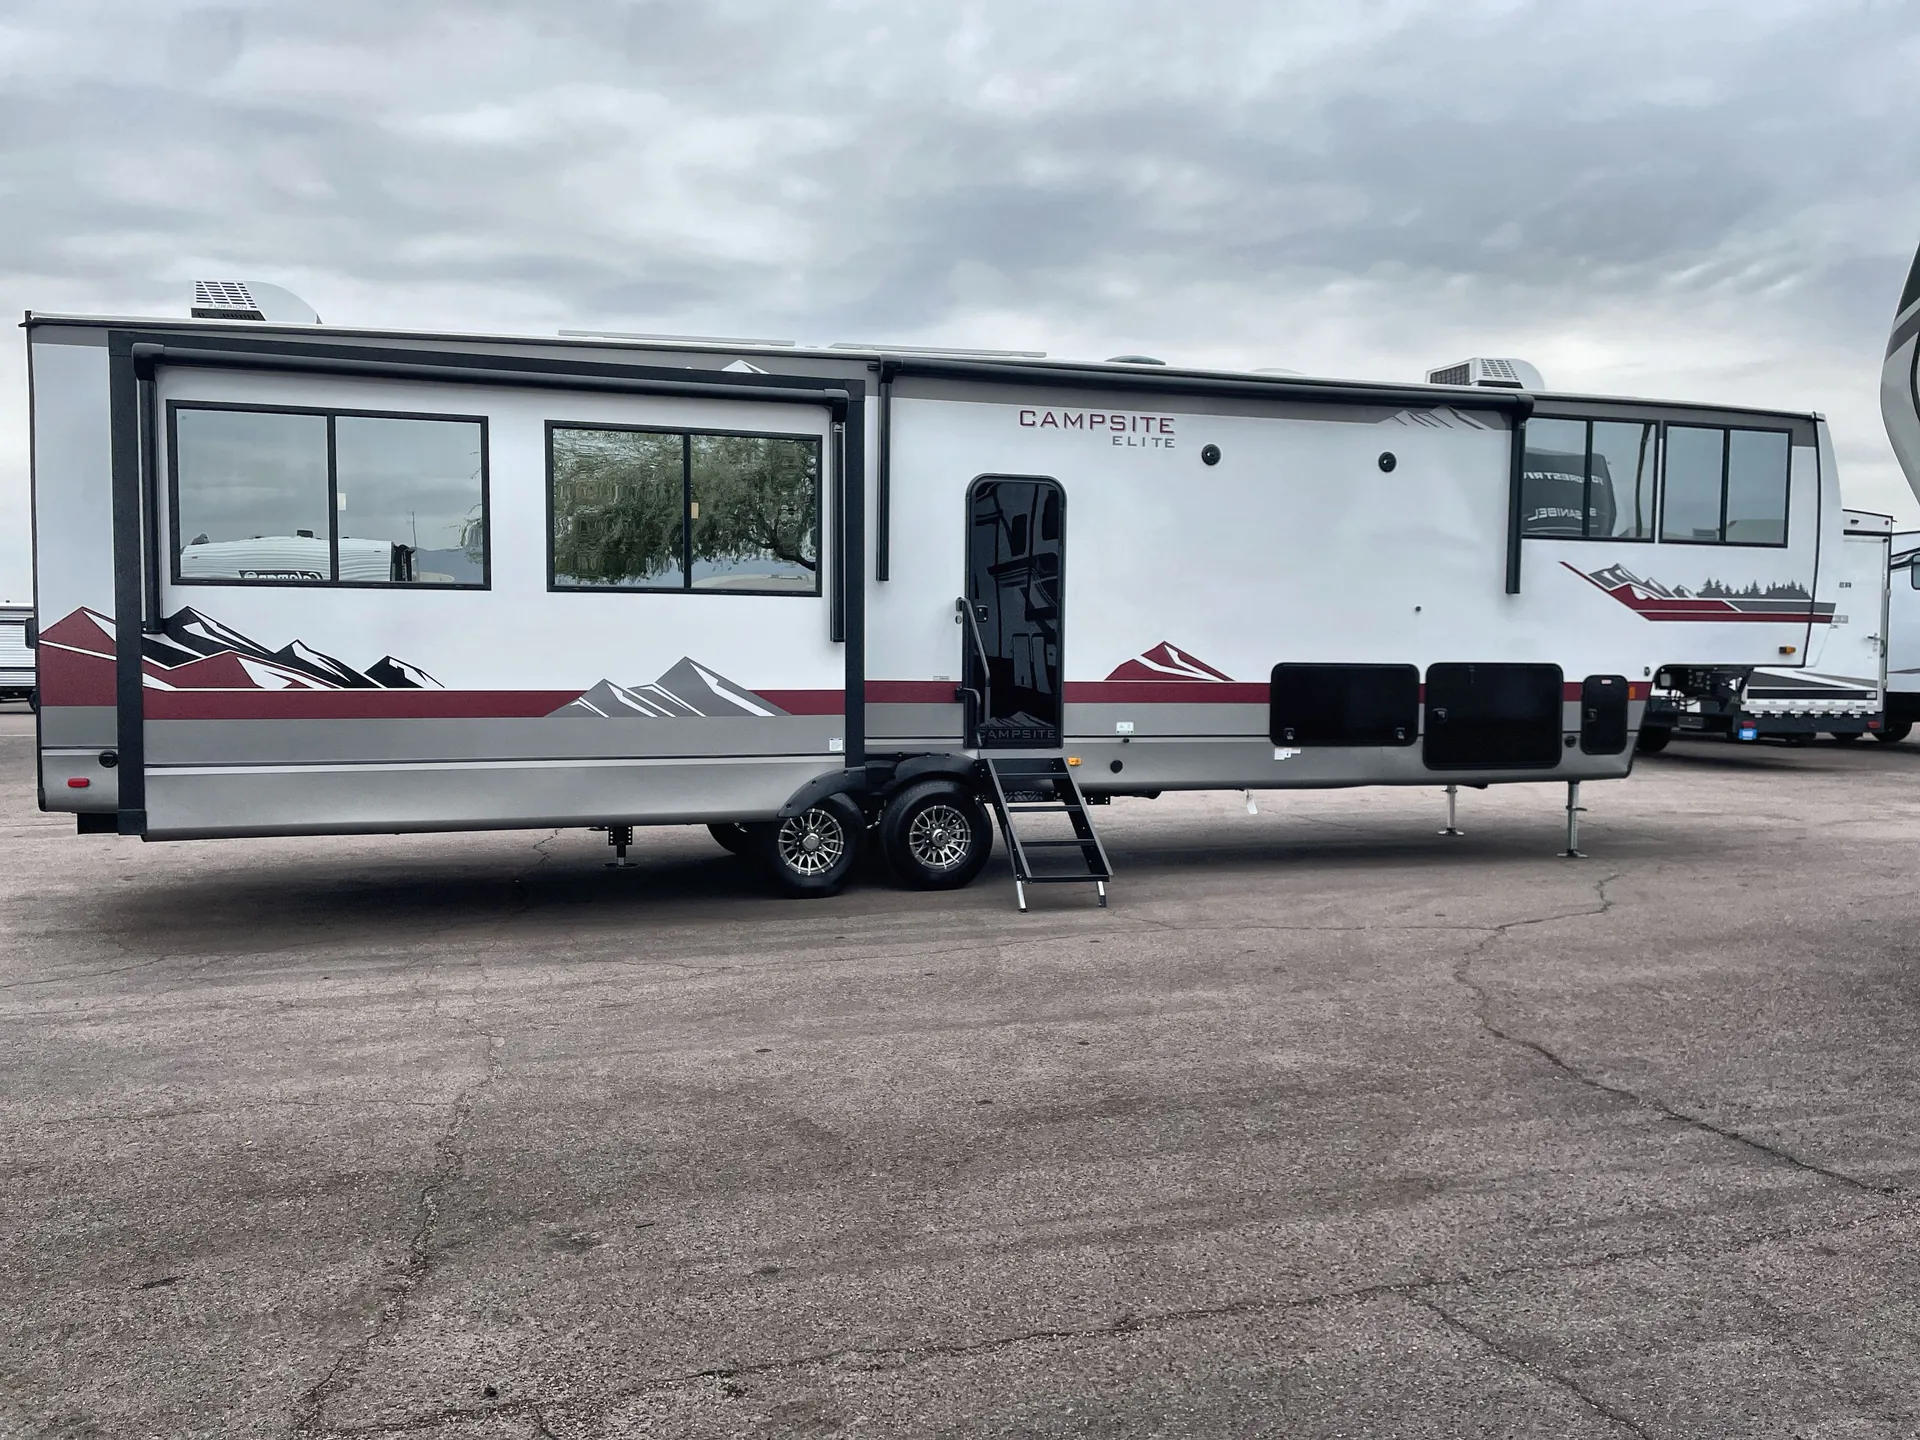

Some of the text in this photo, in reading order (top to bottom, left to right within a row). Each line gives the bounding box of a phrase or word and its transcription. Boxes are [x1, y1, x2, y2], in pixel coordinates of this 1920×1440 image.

[1019, 410, 1175, 434] CAMPSITE
[1112, 435, 1175, 448] ELITE
[980, 729, 1056, 739] CAMPSITE
